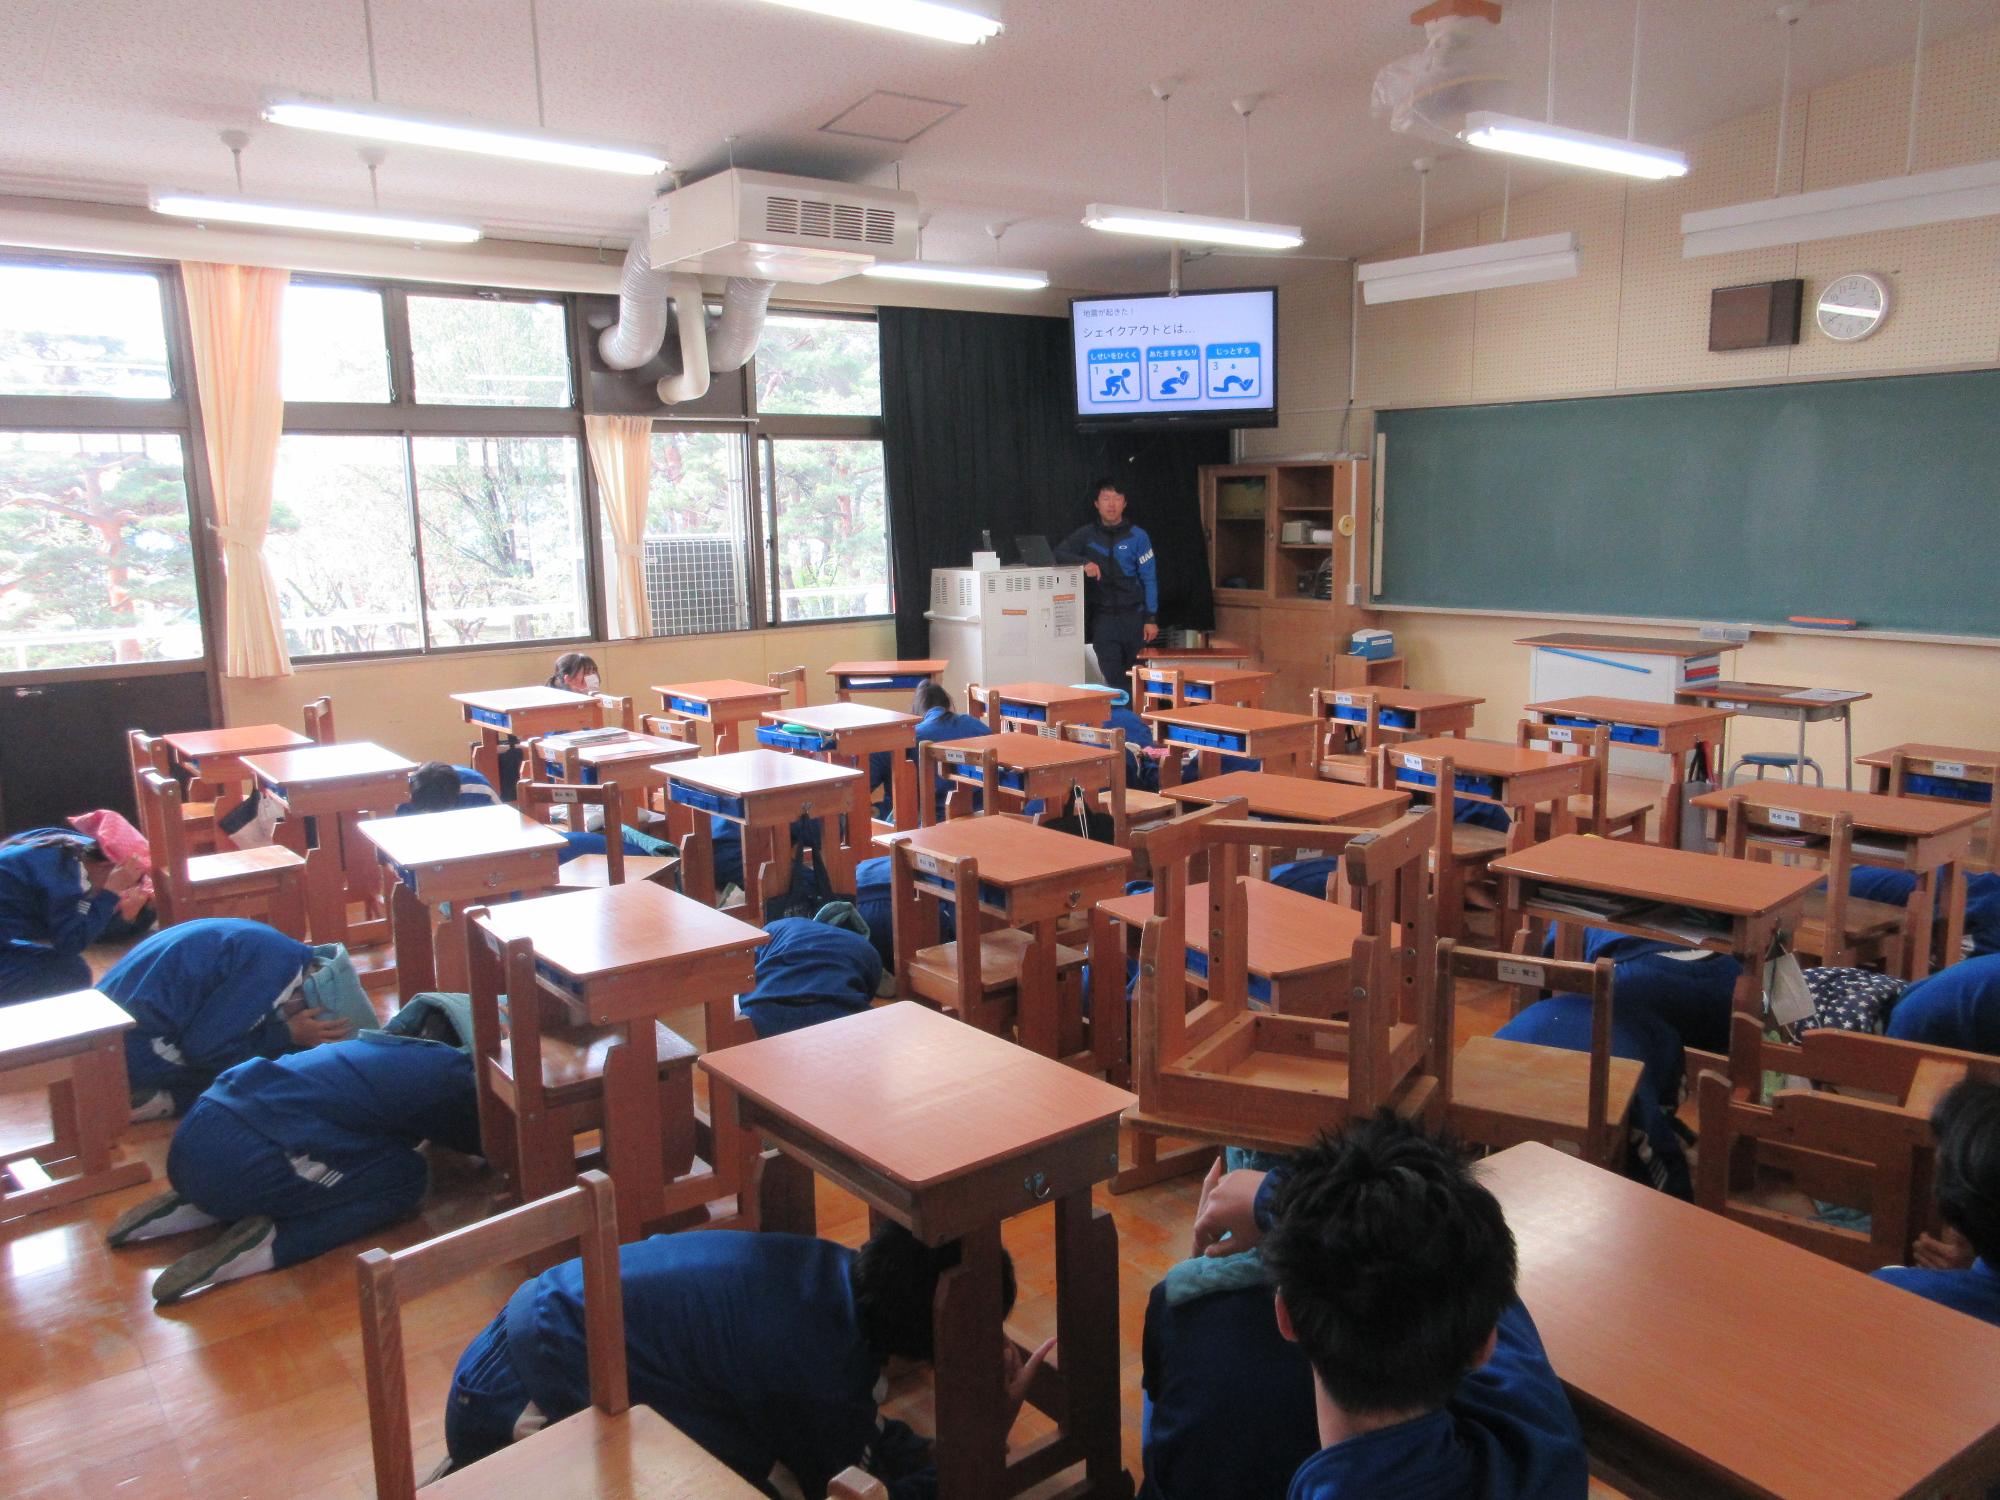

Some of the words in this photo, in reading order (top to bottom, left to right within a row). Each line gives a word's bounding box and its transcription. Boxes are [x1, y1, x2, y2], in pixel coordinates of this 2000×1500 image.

[1090, 350, 1137, 361] しせいをひくく
[1149, 348, 1198, 359] あたまをまもり
[1215, 347, 1251, 356] じっとする
[1093, 366, 1099, 376] 1
[1153, 363, 1159, 373] 2
[1212, 361, 1219, 371] 3
